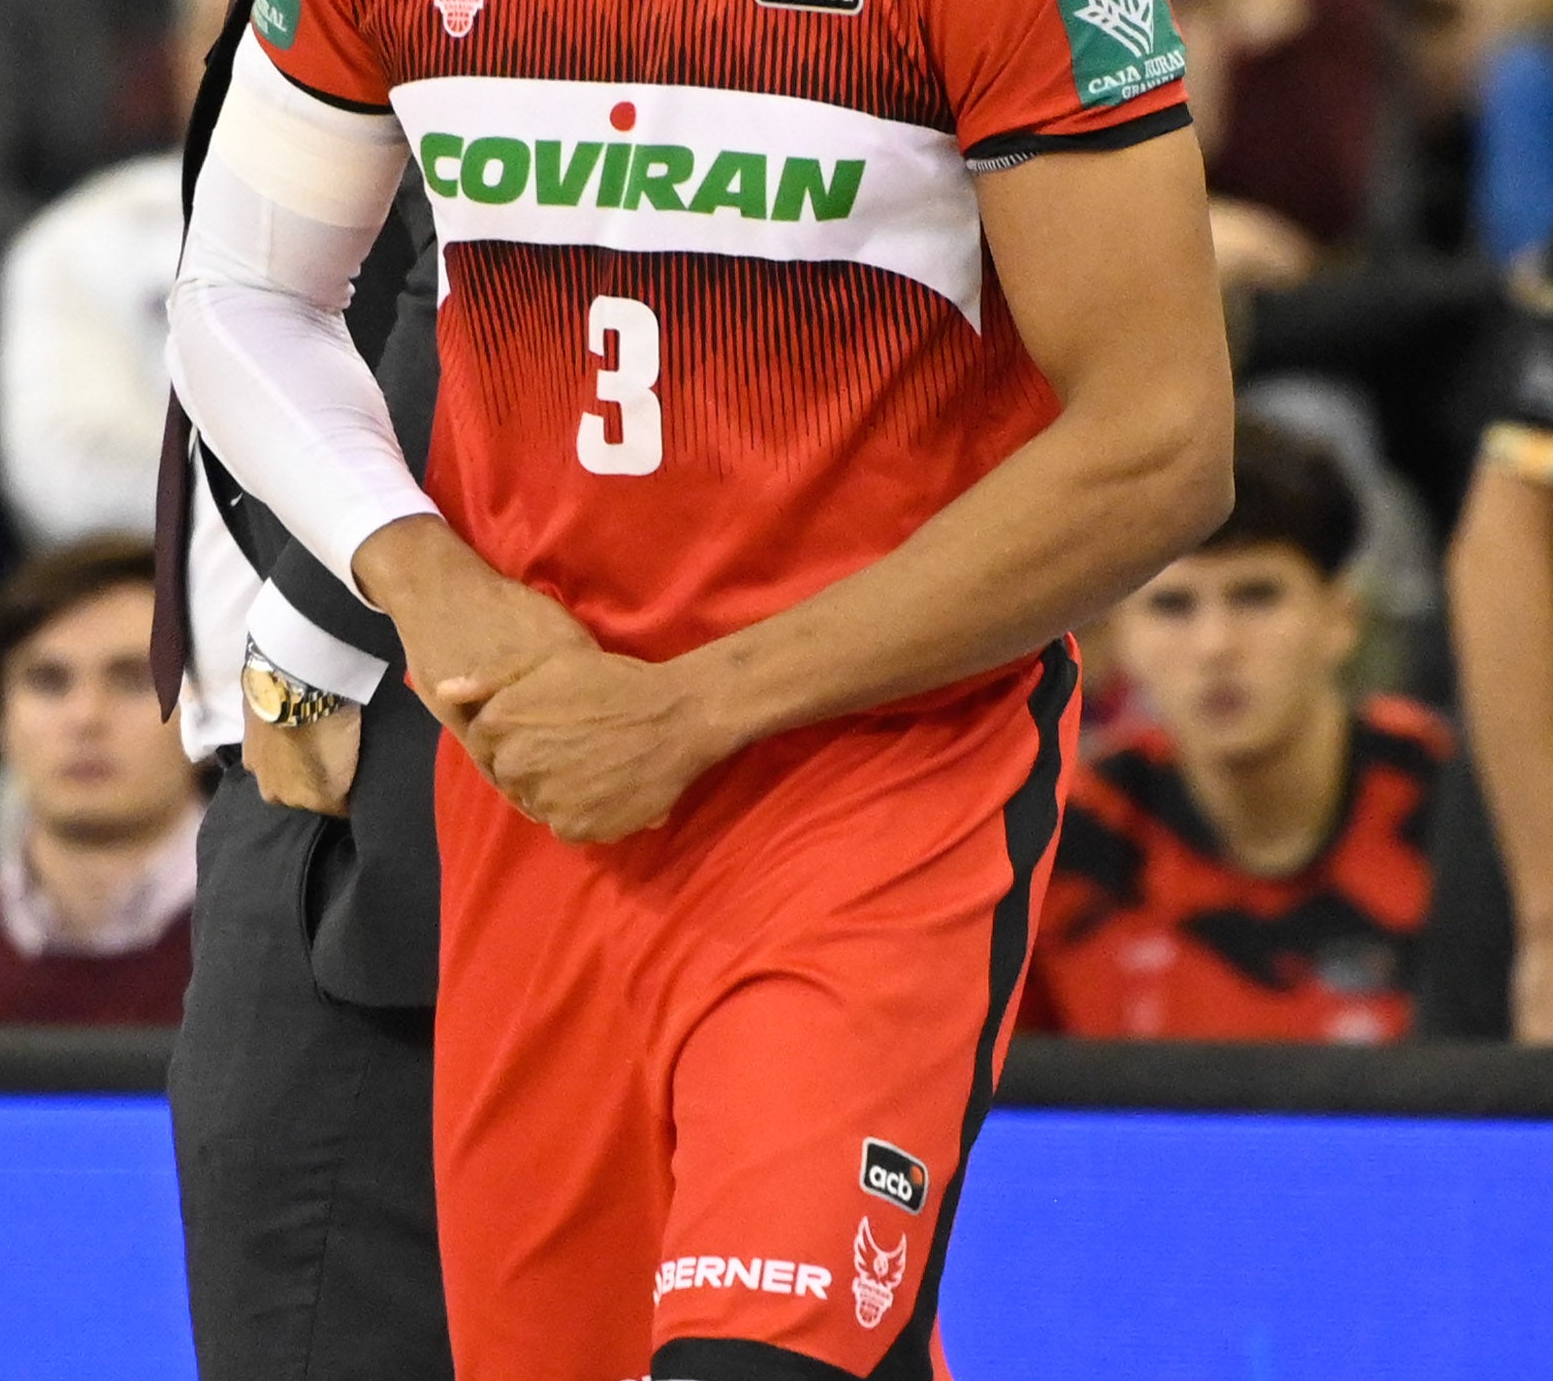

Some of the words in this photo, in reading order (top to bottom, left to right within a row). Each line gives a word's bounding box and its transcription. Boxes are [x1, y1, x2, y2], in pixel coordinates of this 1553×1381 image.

[1087, 65, 1141, 94] CAJA
[419, 101, 867, 223] COVIRAN
[576, 294, 663, 476] 3
[869, 1164, 913, 1202] acb
